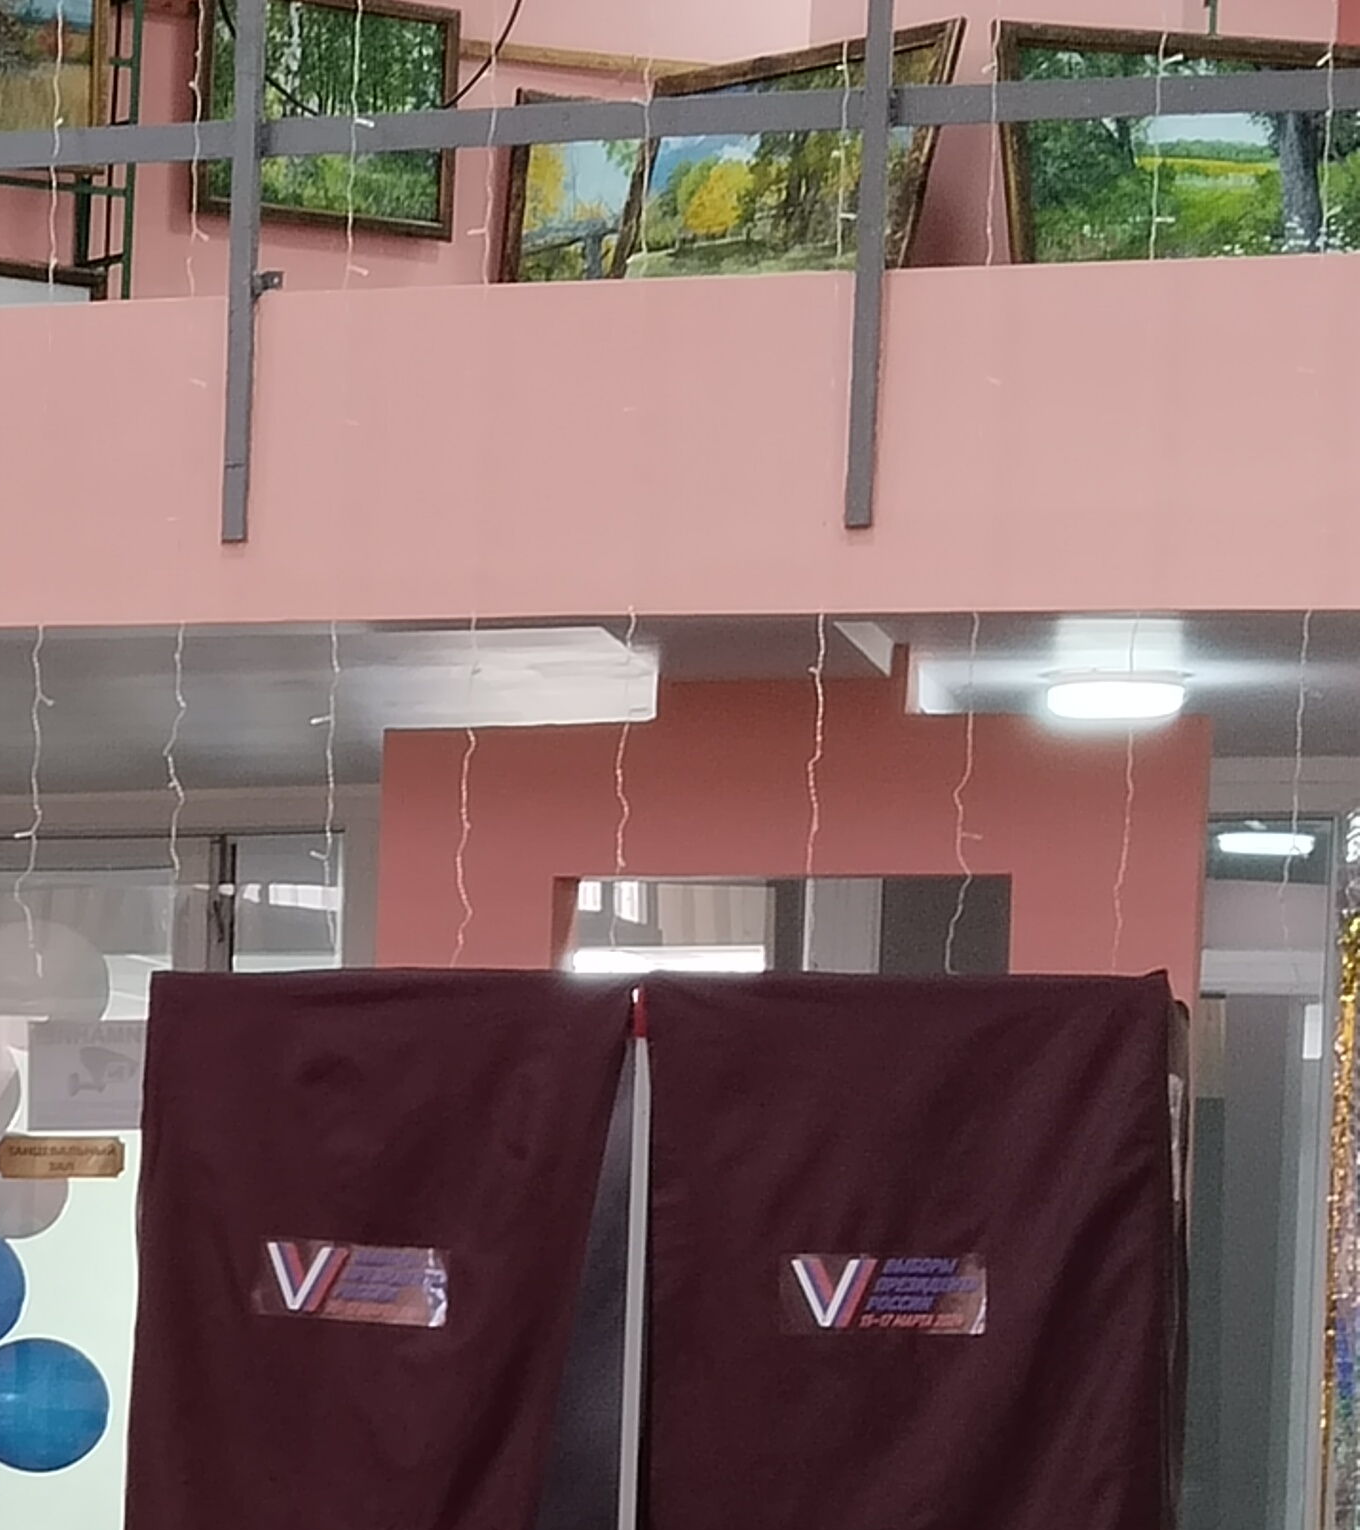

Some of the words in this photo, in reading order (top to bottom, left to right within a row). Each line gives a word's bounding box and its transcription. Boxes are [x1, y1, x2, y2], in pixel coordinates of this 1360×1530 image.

[882, 1257, 958, 1275] ВЫБОРЫ
[865, 1295, 935, 1311] РОССИИ
[891, 1313, 934, 1328] МАРТА
